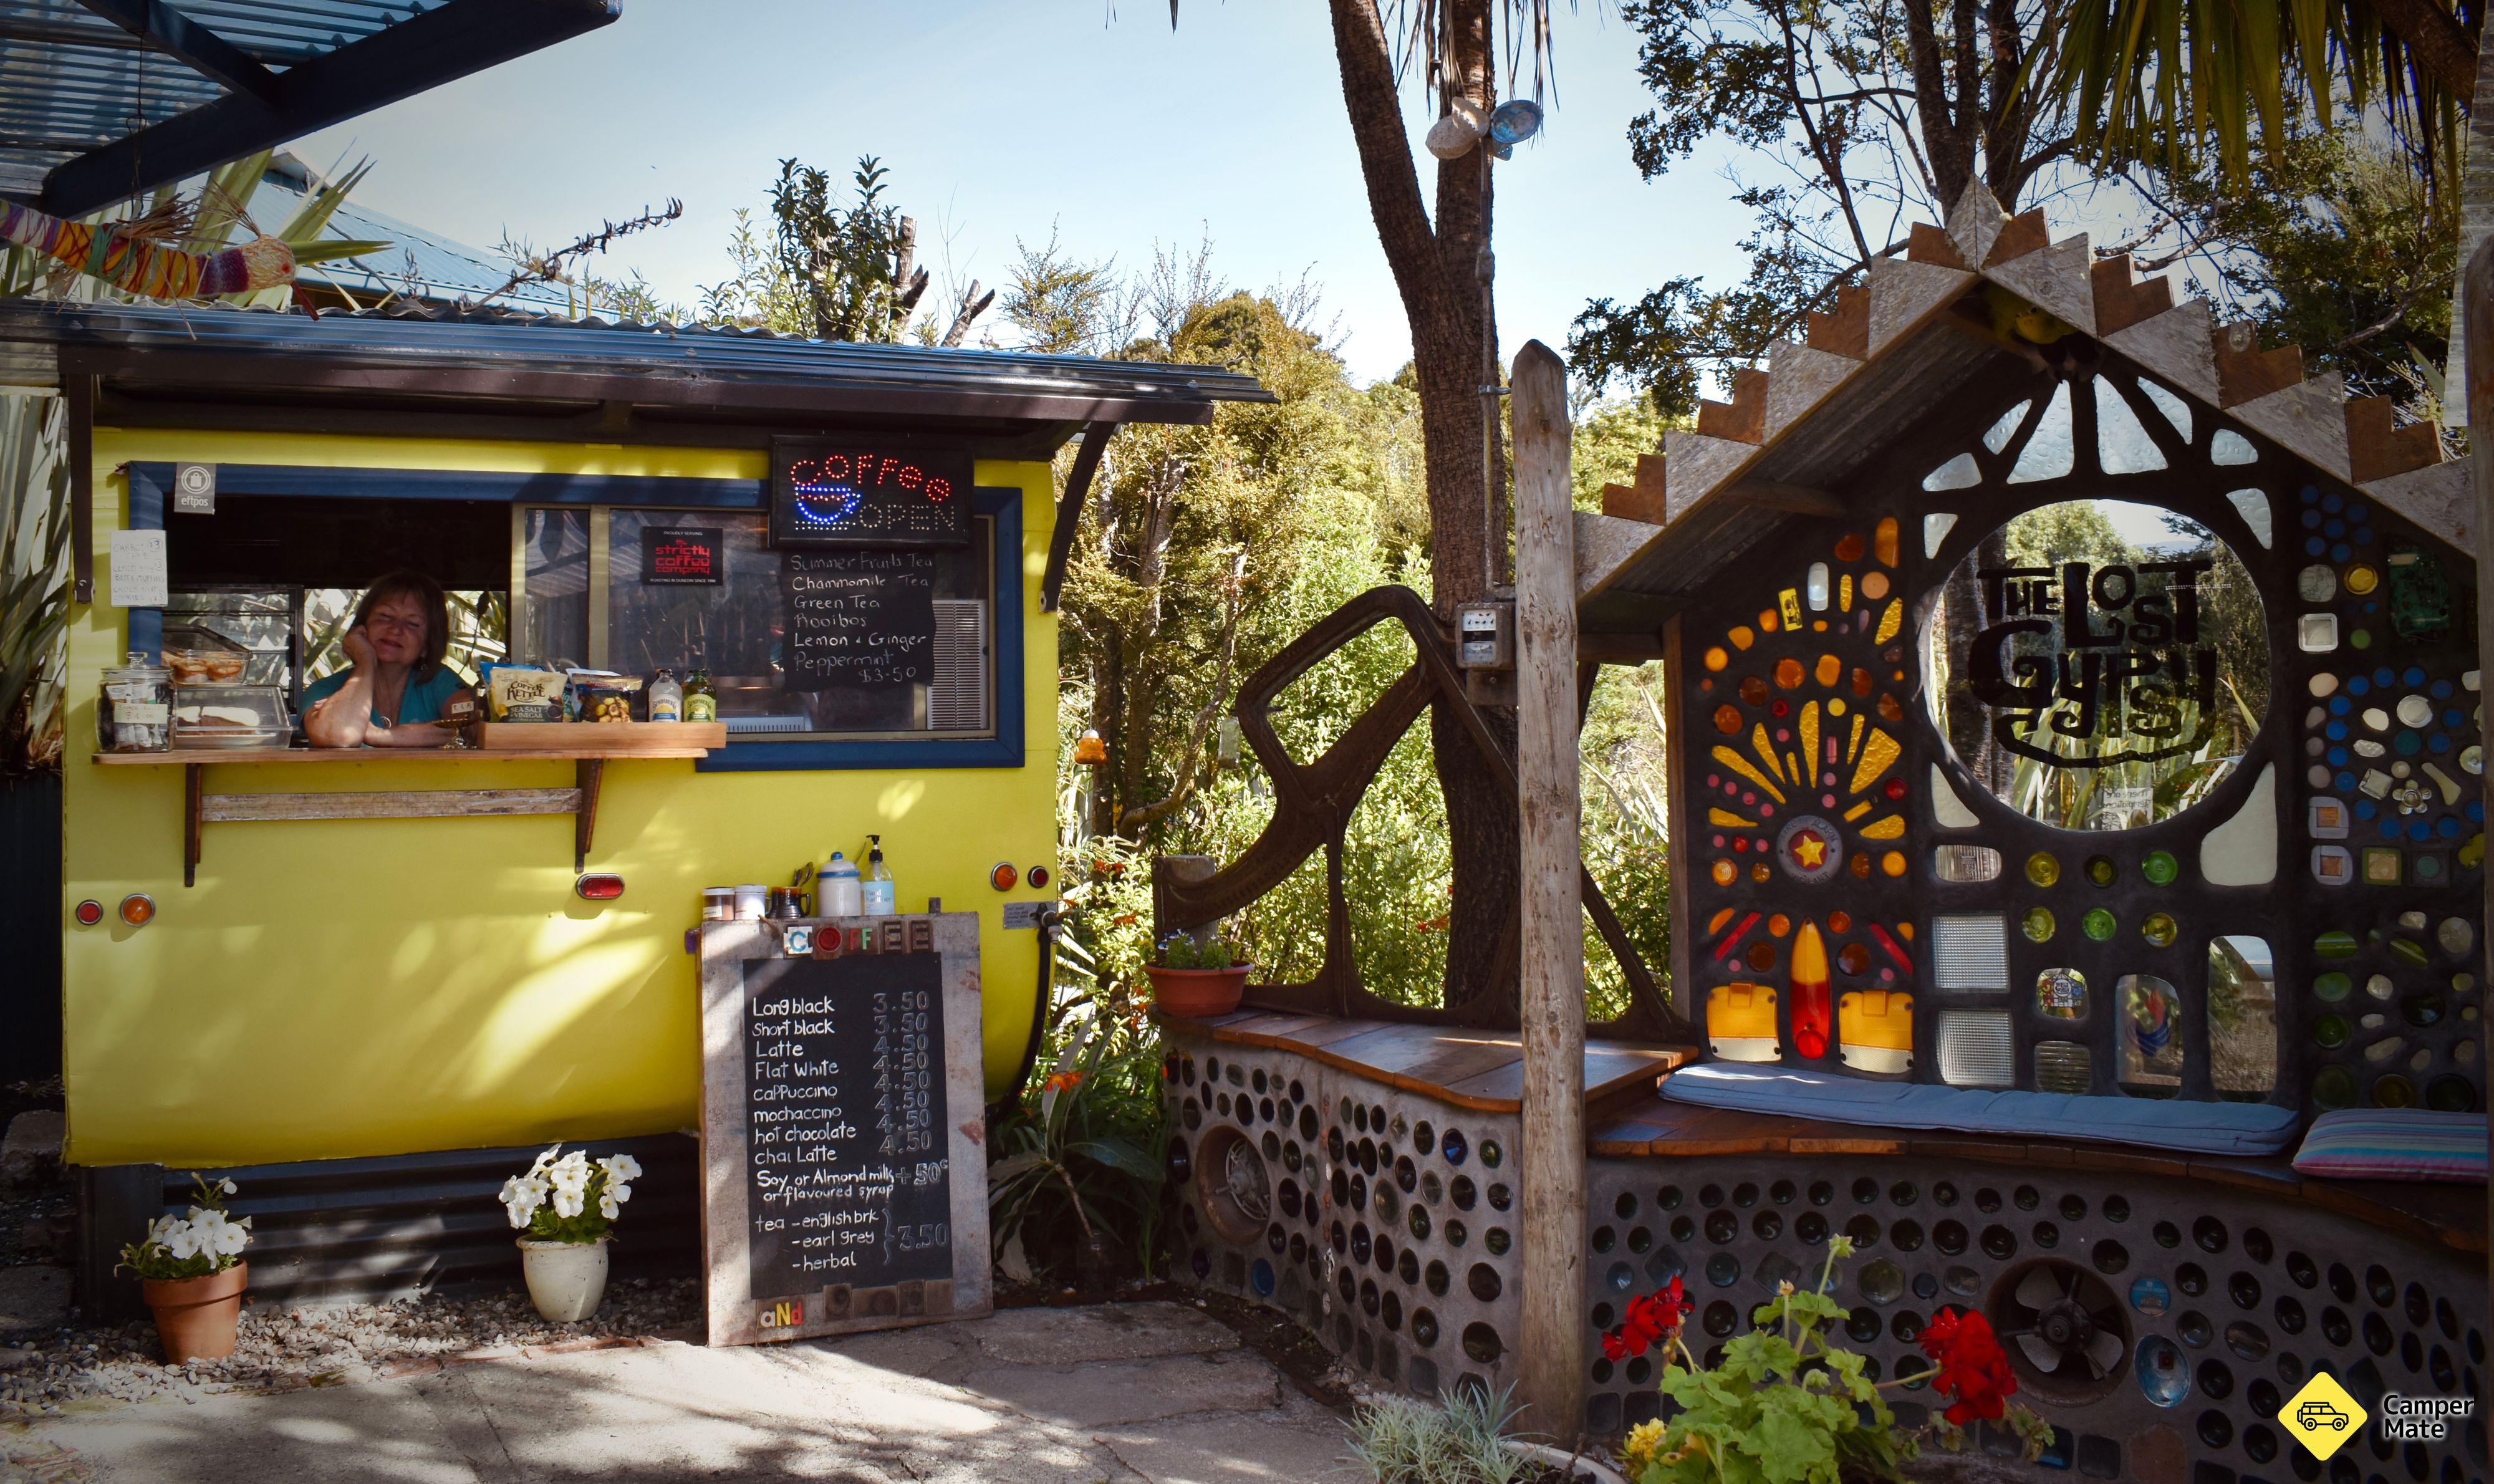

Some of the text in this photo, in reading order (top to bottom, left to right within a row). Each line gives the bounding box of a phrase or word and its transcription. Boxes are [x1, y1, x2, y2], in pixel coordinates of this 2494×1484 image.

[181, 496, 208, 508] eftpos
[859, 504, 955, 530] OPEN
[656, 544, 710, 557] strictly
[656, 555, 710, 566] coffee
[907, 554, 933, 567] Tea
[898, 574, 928, 586] Tea
[794, 594, 880, 609] Green Tea
[1976, 559, 2213, 648] THE LOST
[794, 613, 868, 628] Rooibos
[794, 632, 848, 647] Lemon
[869, 632, 927, 652] Ginger
[794, 649, 893, 677] Peppermint
[753, 991, 929, 1016] Long black 3.50
[752, 1012, 928, 1036] Short black 3.50
[756, 1033, 929, 1058] Latte 4.50
[755, 1051, 929, 1080] Flat White 4.50
[874, 1071, 931, 1092] 4.50
[753, 1091, 930, 1122] mochaccino 4.50
[755, 1109, 932, 1145] hot chocolate 4.50
[754, 1130, 932, 1165] chai Latte 4.50
[757, 1170, 788, 1194] Soy
[794, 1173, 811, 1185] or
[813, 1164, 866, 1183] Almond
[763, 1190, 778, 1202] or
[783, 1185, 852, 1207] flavoured
[755, 1215, 785, 1233] tea
[898, 1223, 949, 1251] 3.50
[840, 1231, 874, 1246] grey
